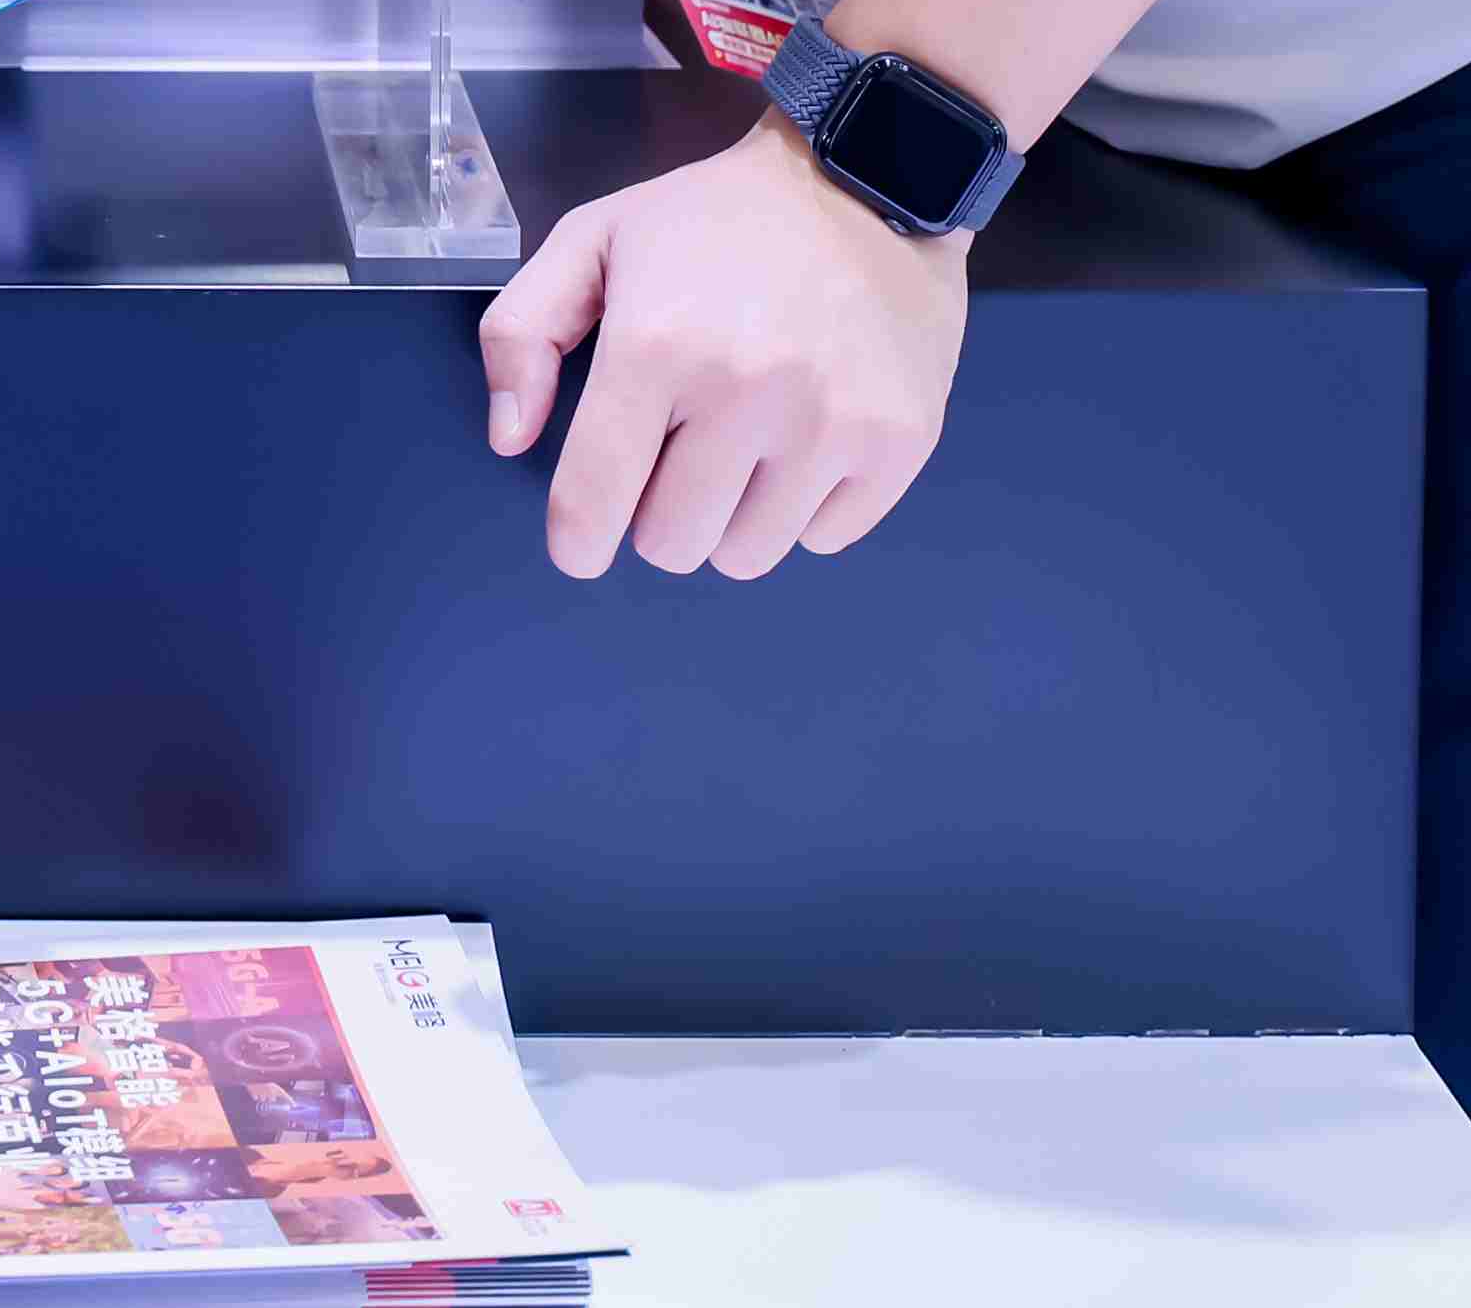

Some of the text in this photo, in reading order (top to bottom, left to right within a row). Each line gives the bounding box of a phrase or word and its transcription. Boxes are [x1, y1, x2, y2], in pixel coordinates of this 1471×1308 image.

[382, 939, 431, 988] MEIG
[17, 979, 135, 1183] 5G+AIoT模组
[83, 974, 184, 1109] 美格智能
